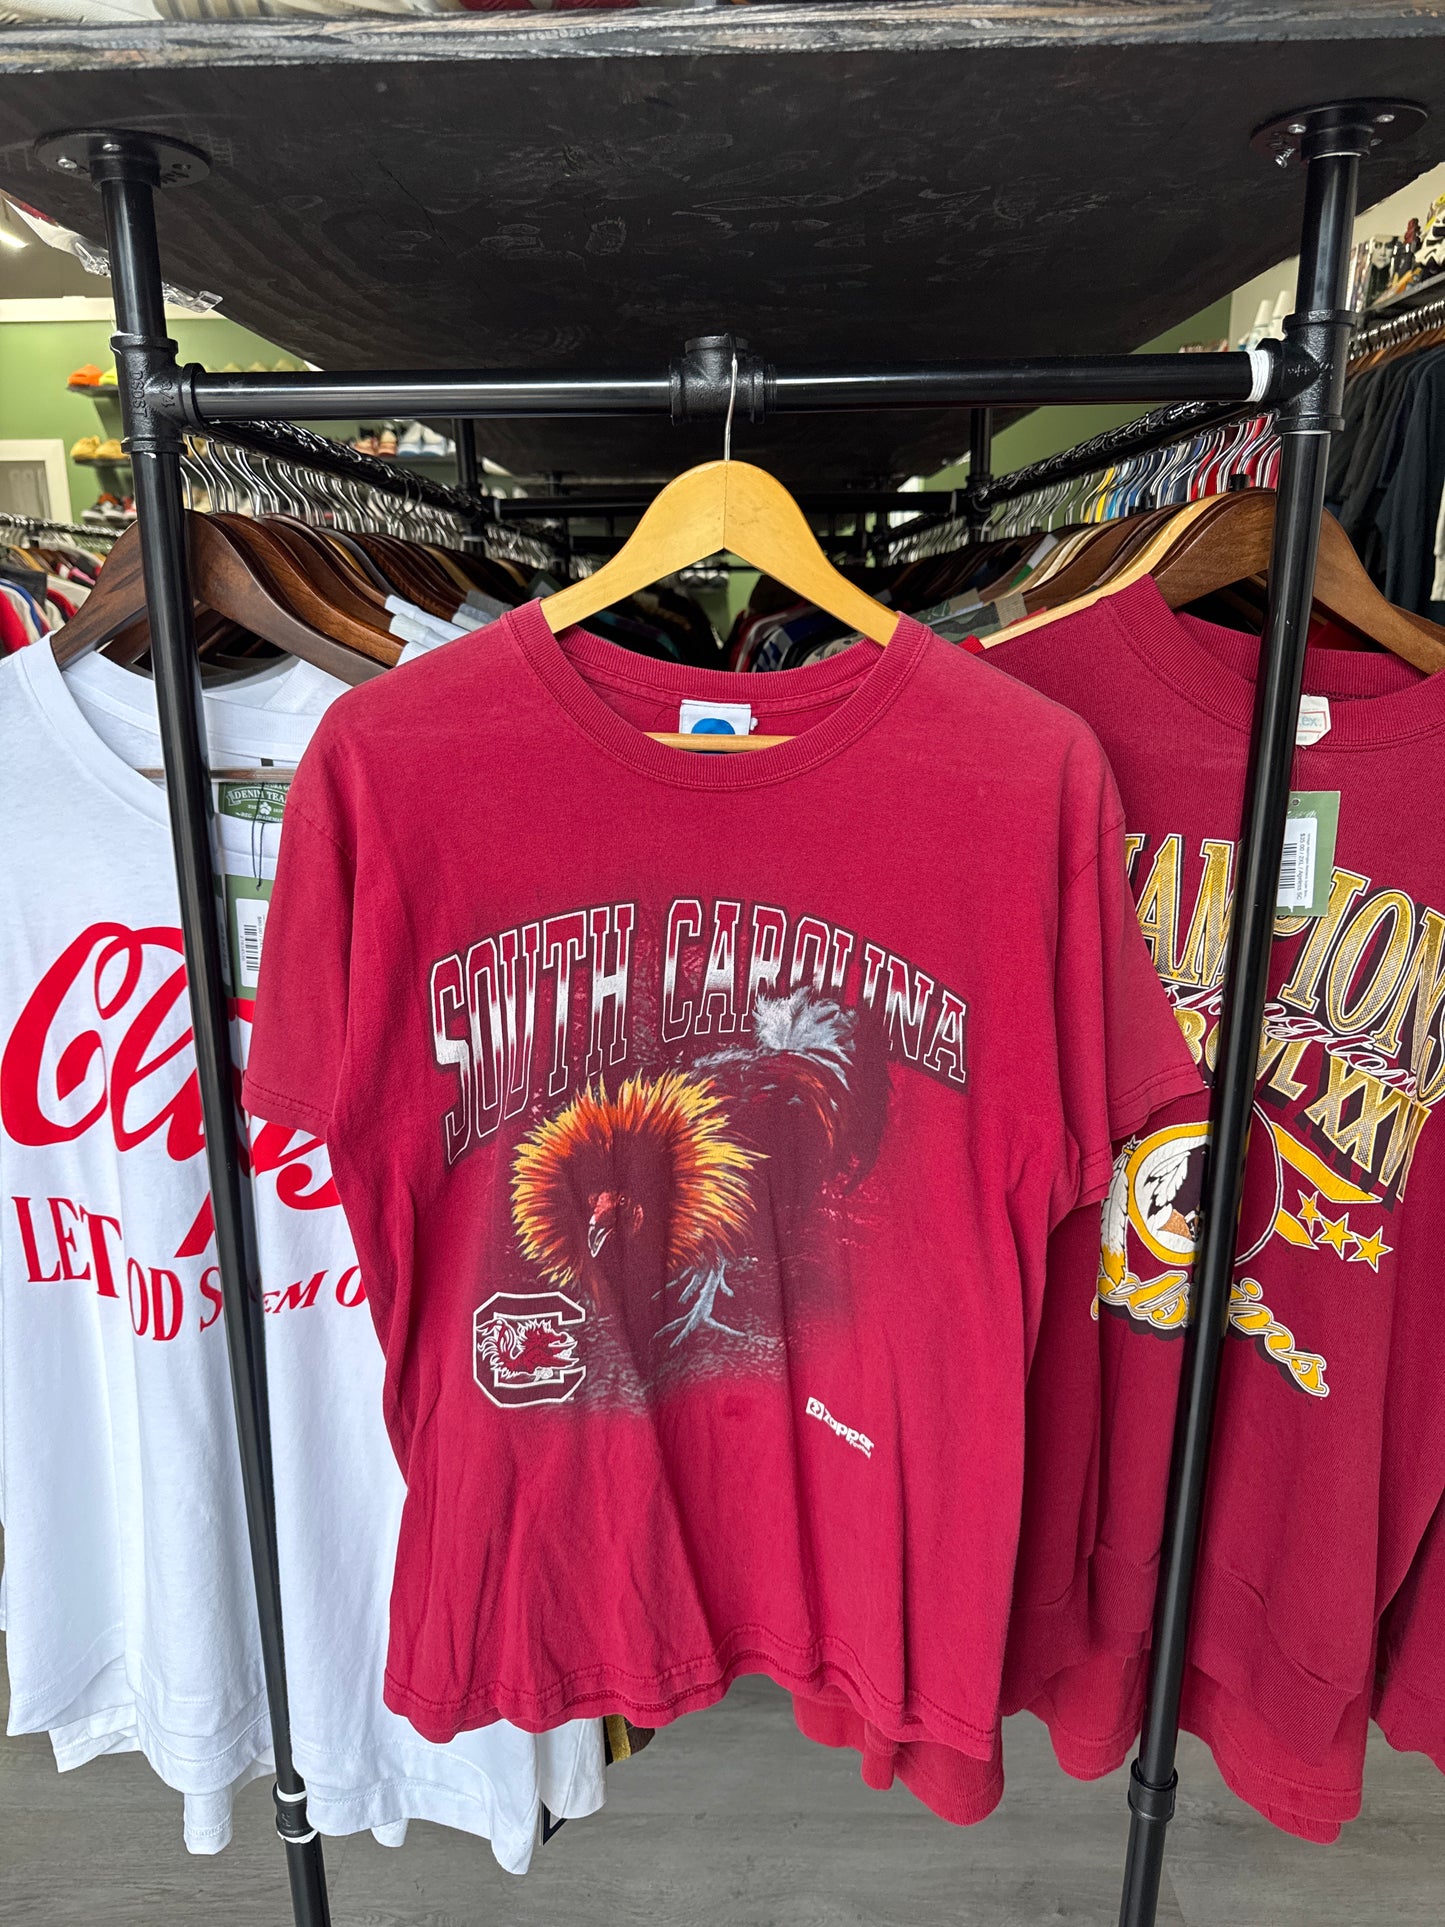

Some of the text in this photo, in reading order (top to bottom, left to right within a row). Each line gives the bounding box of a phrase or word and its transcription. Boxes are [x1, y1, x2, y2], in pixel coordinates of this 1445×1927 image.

[266, 792, 286, 804] TEA
[430, 902, 635, 1166] SOUTH
[11, 1196, 122, 1299] LET
[127, 1257, 184, 1341] OD
